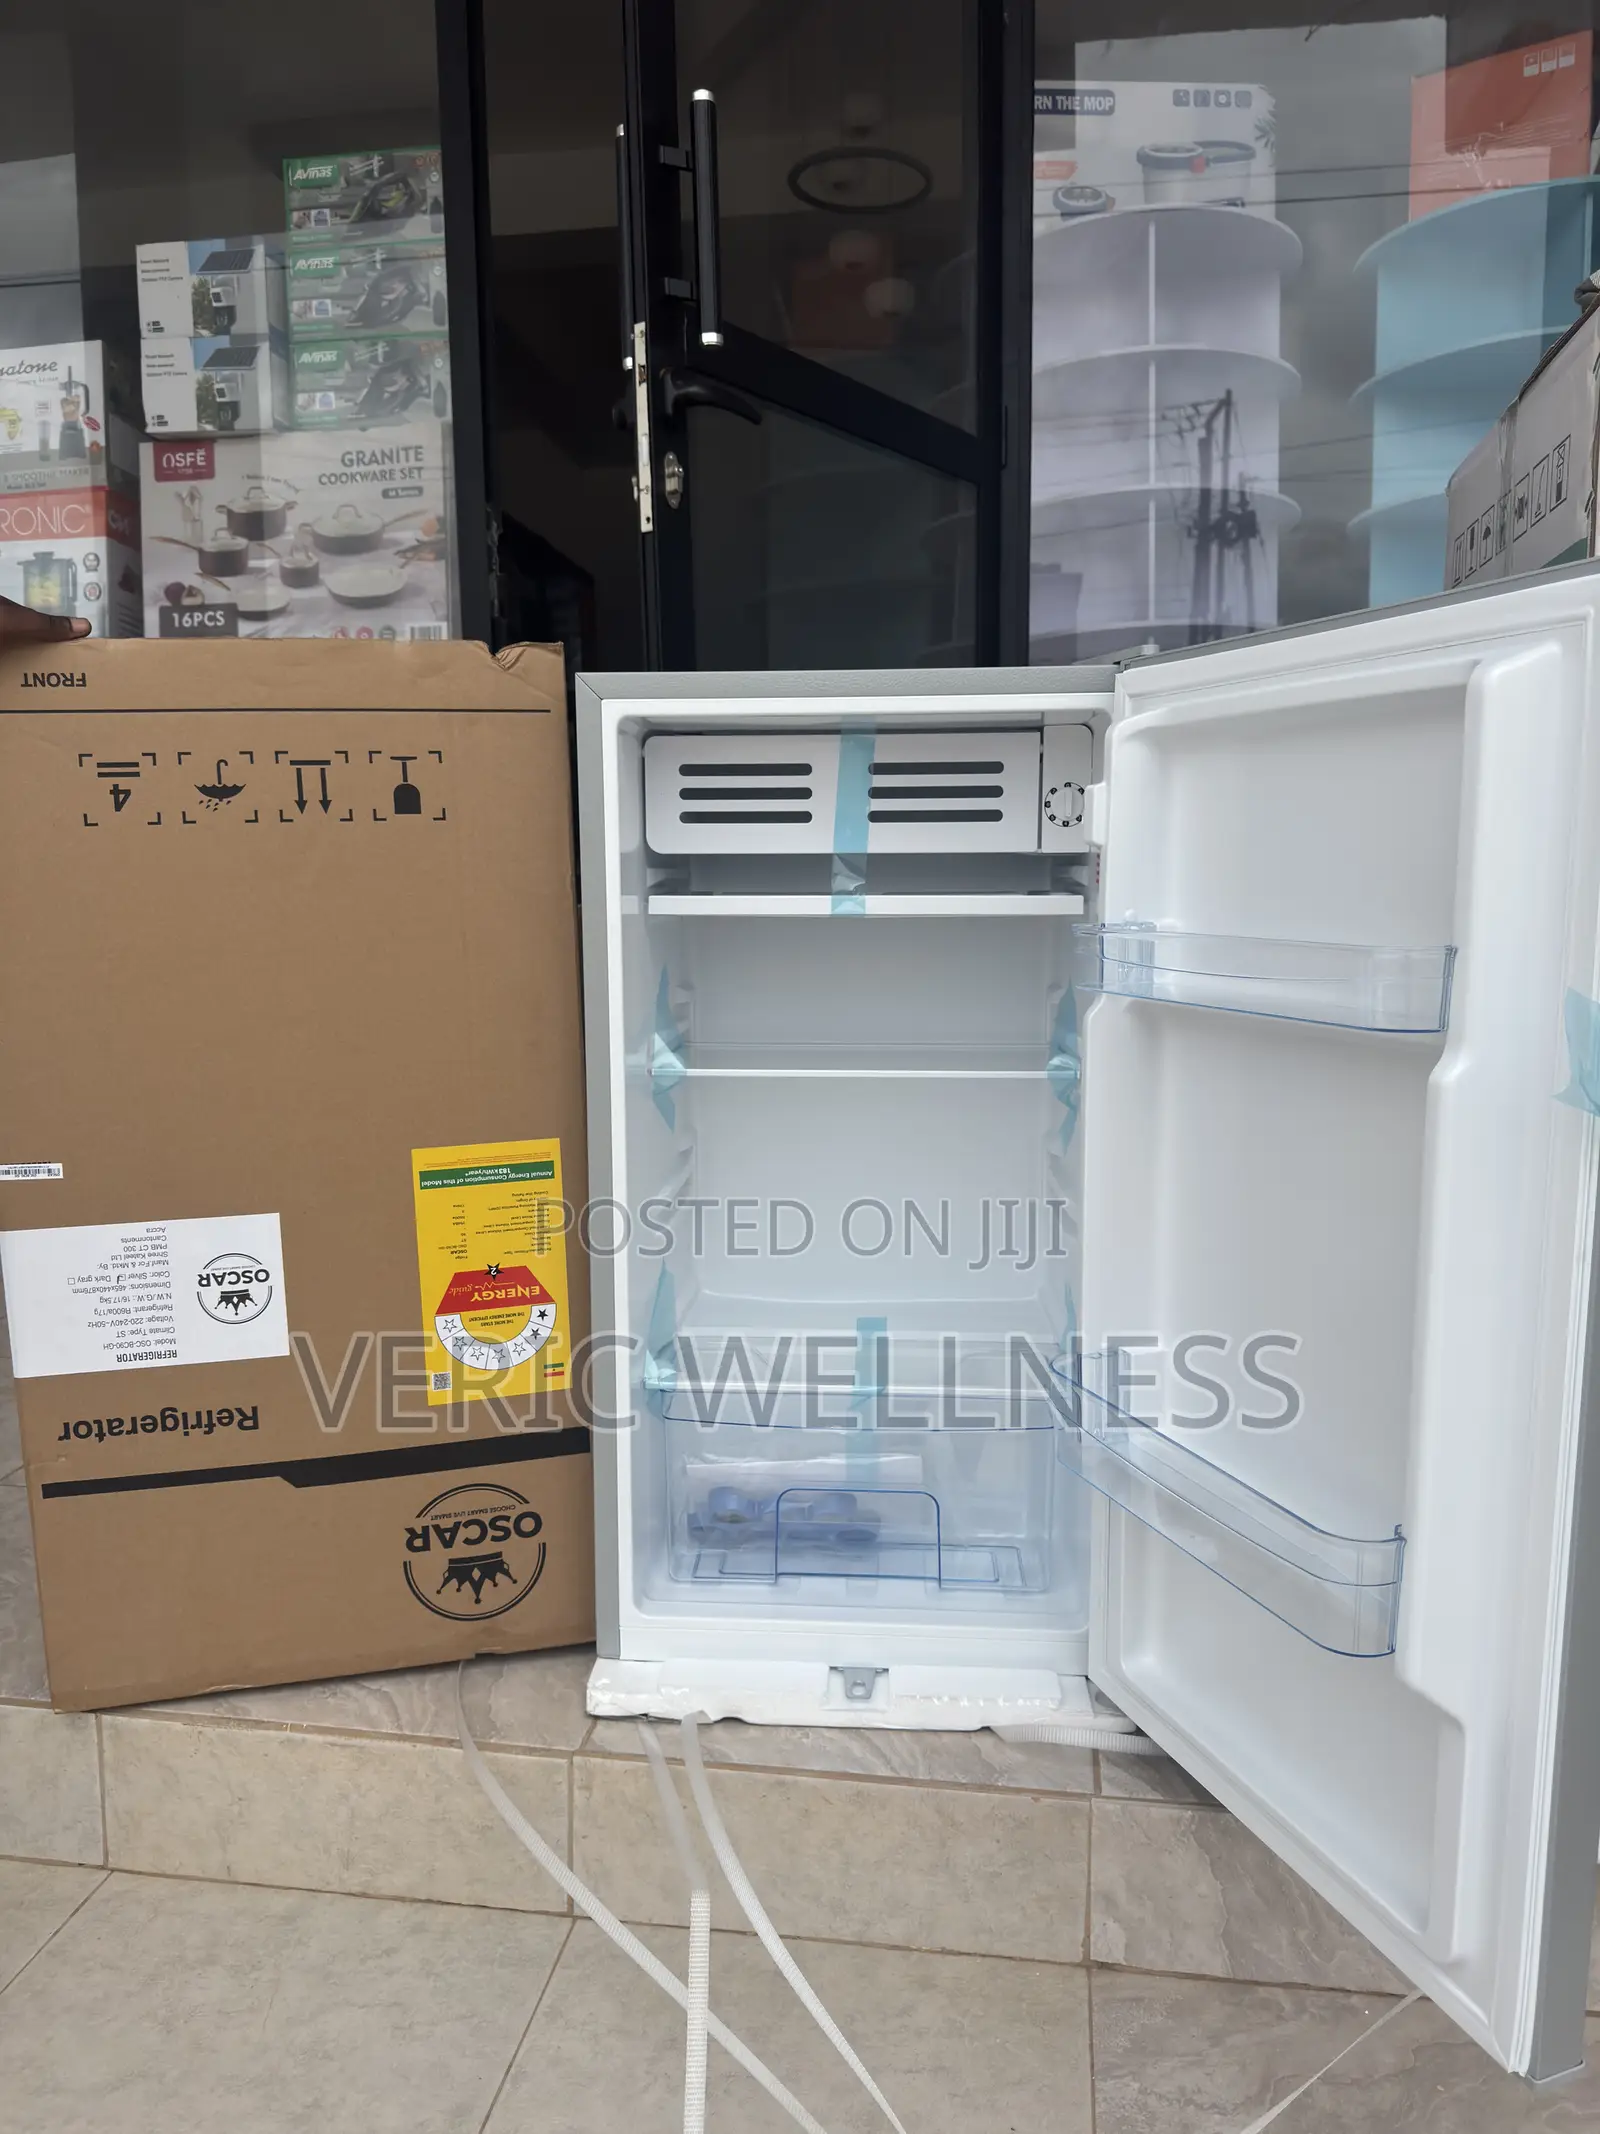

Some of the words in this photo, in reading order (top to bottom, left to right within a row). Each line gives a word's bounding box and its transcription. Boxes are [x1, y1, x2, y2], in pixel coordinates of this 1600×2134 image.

[1056, 96, 1080, 110] THE
[1084, 96, 1114, 111] MOP
[340, 444, 424, 468] GRANITE
[318, 468, 396, 486] COOKWARE
[399, 466, 424, 480] SET
[172, 610, 226, 628] 16PCS
[20, 672, 87, 688] FRONT
[109, 784, 131, 812] 4
[465, 1174, 507, 1183] Consumption
[121, 1235, 167, 1244] Cantonments
[95, 1275, 111, 1283] Dark
[197, 1268, 270, 1287] OSCAR
[129, 1281, 171, 1290] Dimensions:
[448, 1284, 473, 1296] guide
[470, 1284, 540, 1302] ENERGY
[94, 1307, 131, 1316] R600a/17g
[132, 1303, 173, 1313] Refrigerant:
[128, 1328, 147, 1336] Type:
[103, 1340, 151, 1350] OSC-BC90-GH
[116, 1350, 177, 1362] REFRIGERATOR
[58, 1406, 259, 1443] Refrigerator
[489, 1504, 516, 1513] CHOOSE
[404, 1511, 542, 1553] OSCAR
